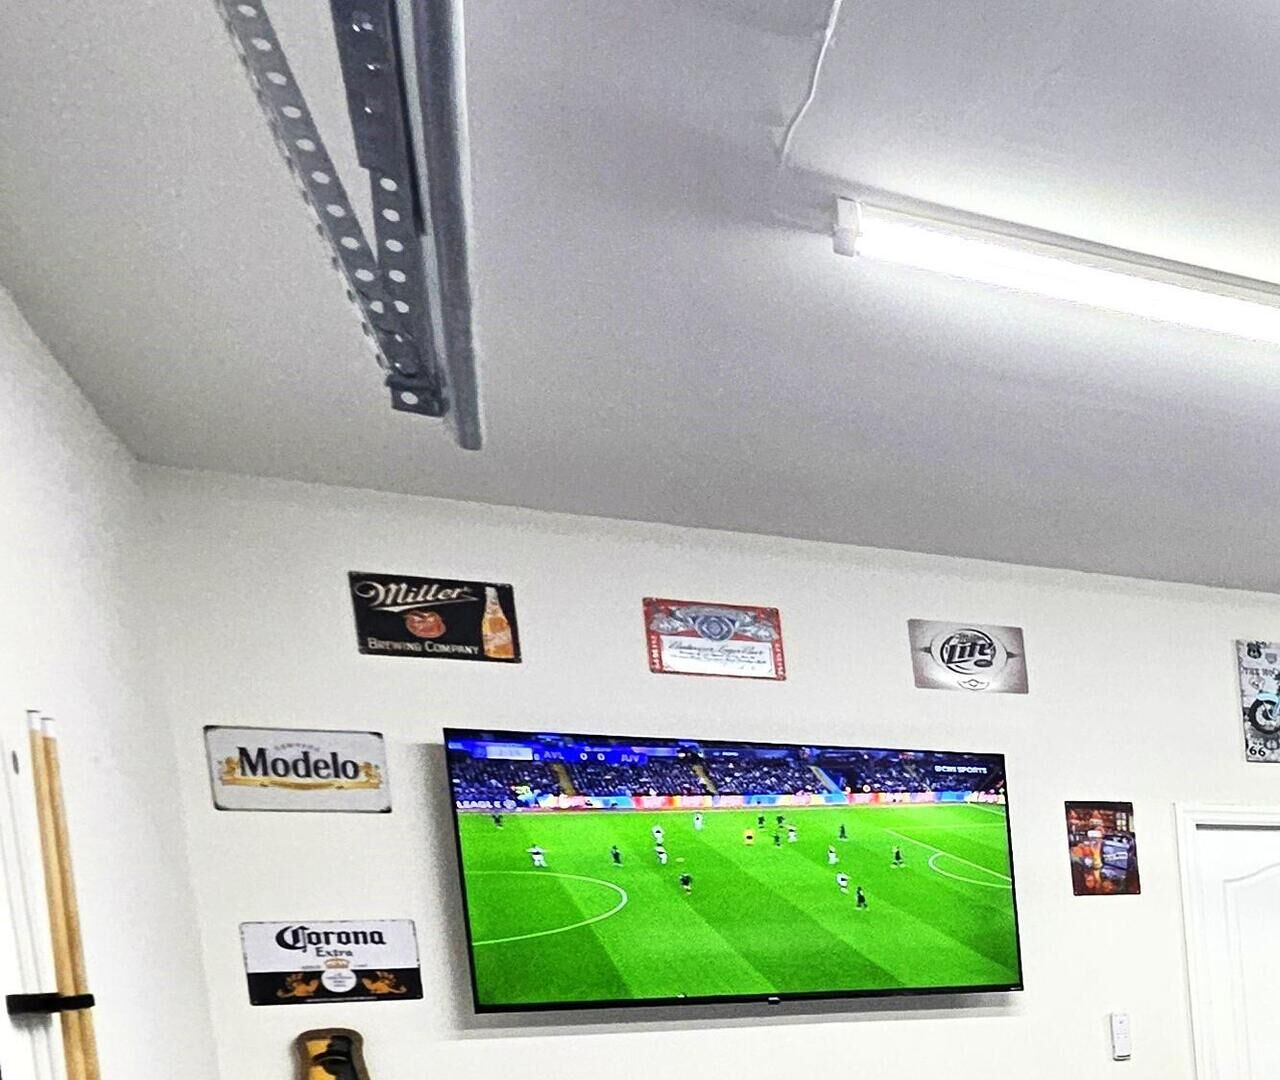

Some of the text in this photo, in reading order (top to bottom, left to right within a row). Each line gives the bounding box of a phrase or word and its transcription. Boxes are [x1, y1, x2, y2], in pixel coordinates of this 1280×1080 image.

[354, 581, 479, 612] Miller
[424, 640, 479, 655] COMPANY
[1249, 746, 1266, 757] 66
[237, 746, 360, 780] Modelo
[275, 925, 387, 953] Corona
[315, 947, 354, 958] Extra
